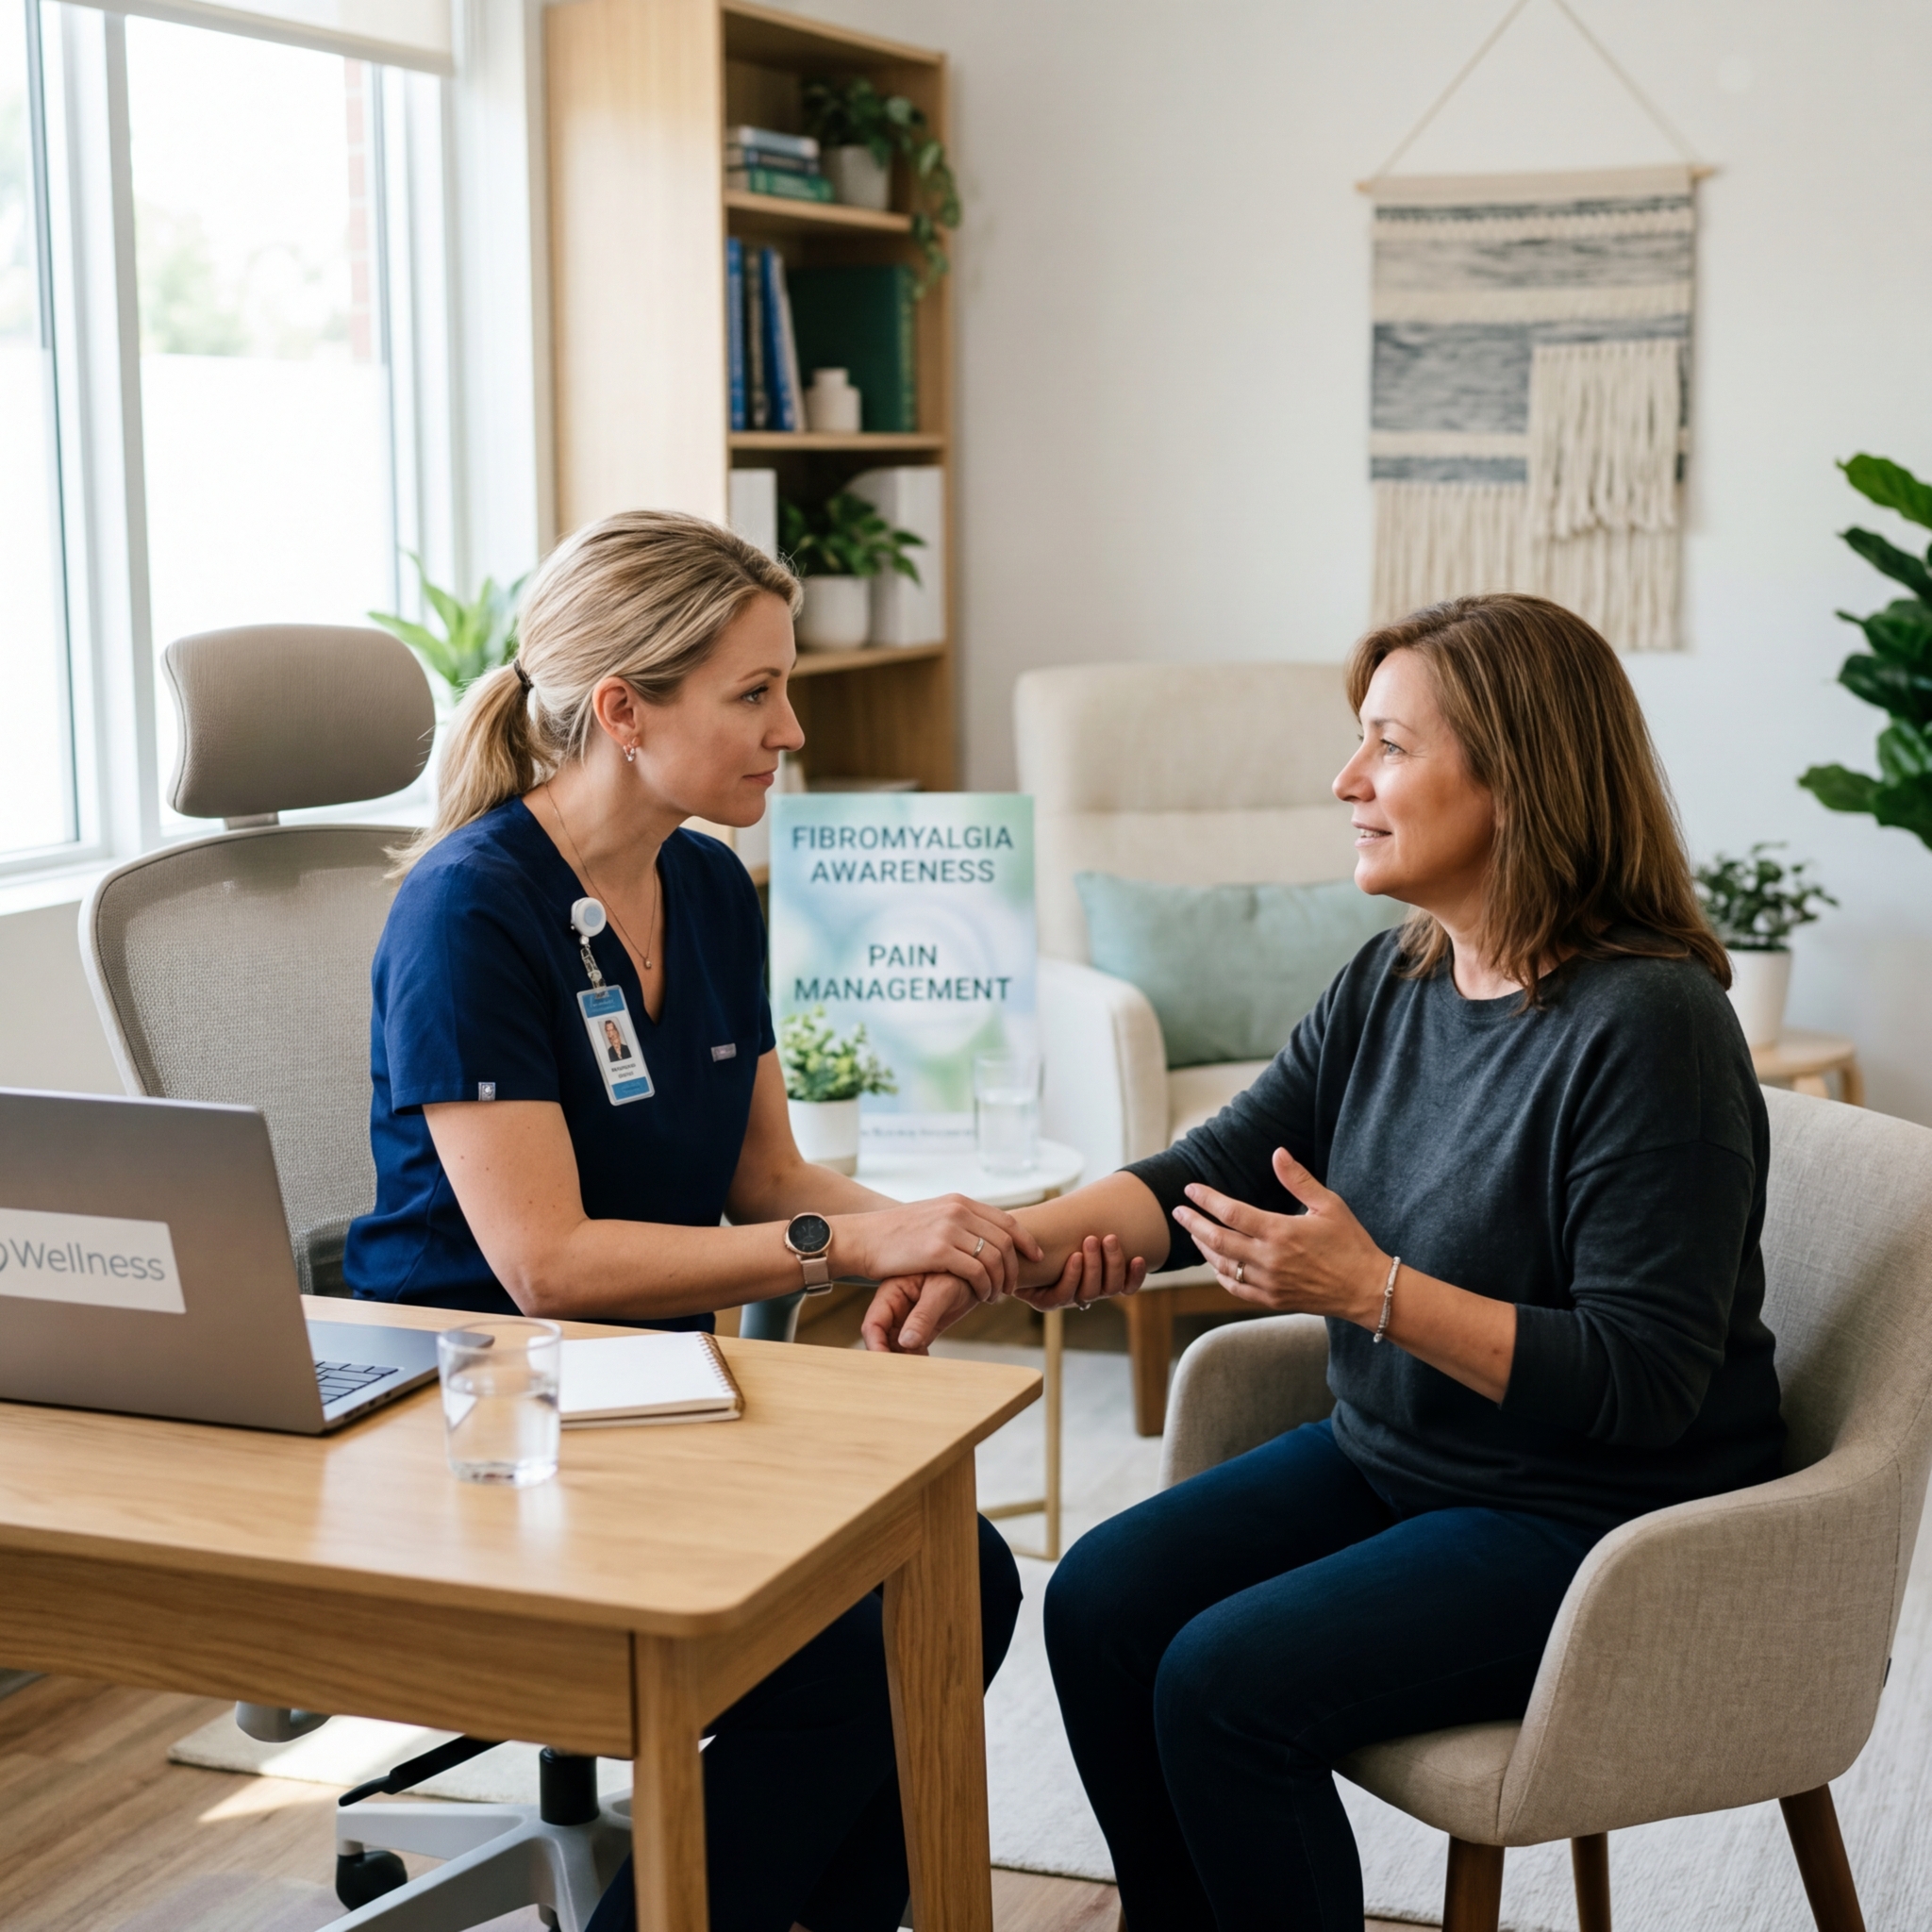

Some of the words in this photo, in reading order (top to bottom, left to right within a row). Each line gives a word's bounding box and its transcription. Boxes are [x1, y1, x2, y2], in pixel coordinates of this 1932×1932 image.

[792, 826, 1013, 849] FIBROMYALGIA
[811, 860, 995, 883] AWARENESS
[869, 945, 937, 967] PAIN
[794, 977, 1012, 1001] MANAGEMENT
